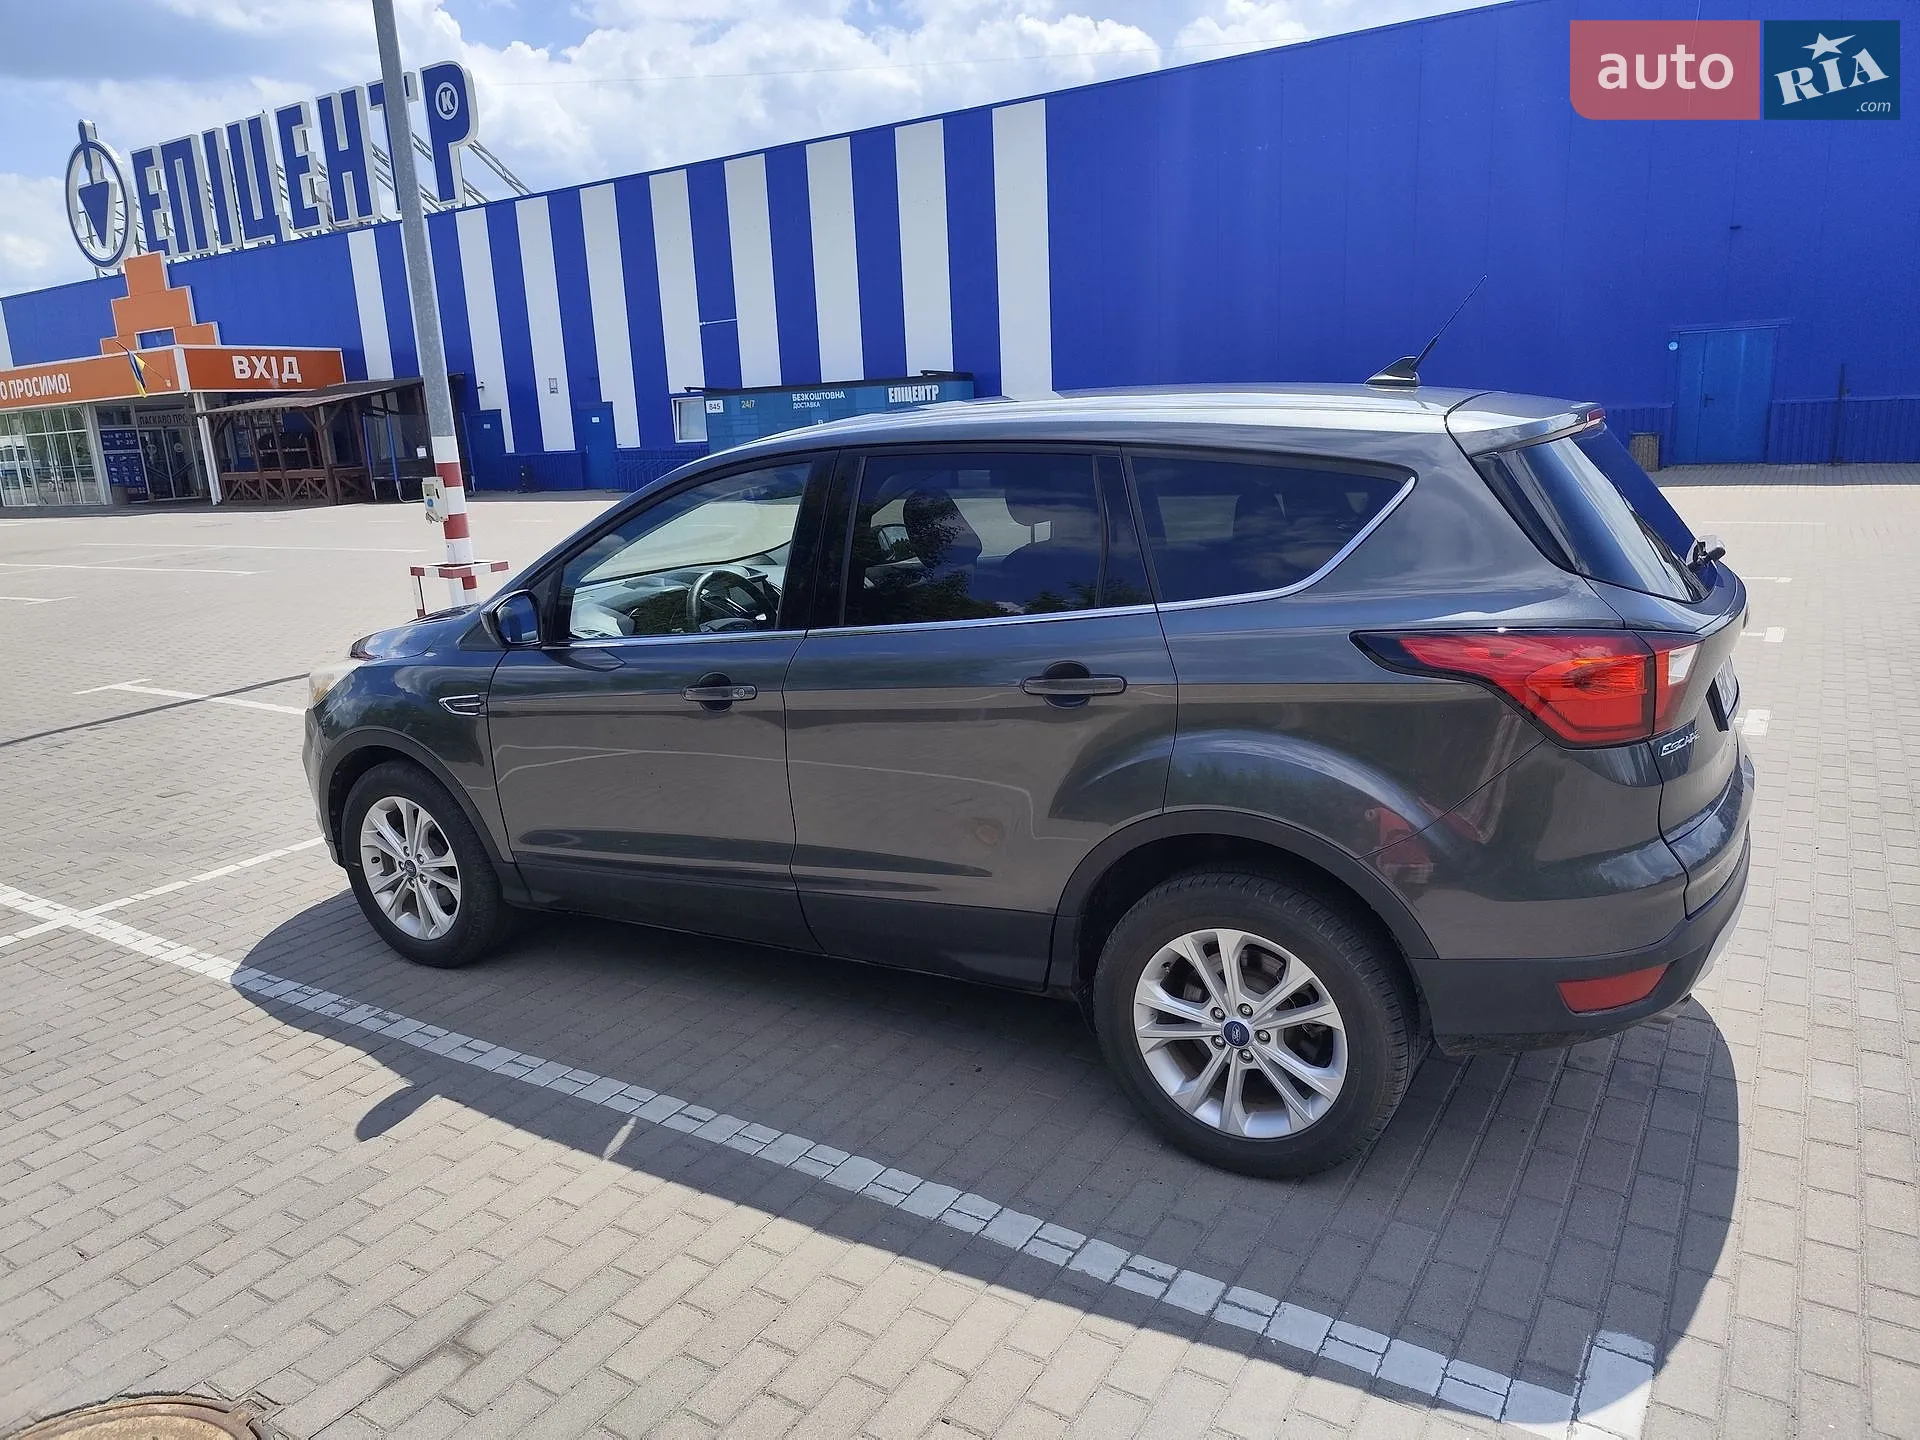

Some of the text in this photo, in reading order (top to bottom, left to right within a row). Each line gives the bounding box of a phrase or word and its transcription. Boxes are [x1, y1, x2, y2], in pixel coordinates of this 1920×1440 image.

[232, 355, 302, 383] ВХІД
[8, 373, 72, 399] ПРОСИМО!
[888, 384, 939, 403] ЕПІЦЕНТР
[792, 391, 846, 401] БЕЗКОШТОВНА
[792, 401, 821, 410] ДОСТАВКА
